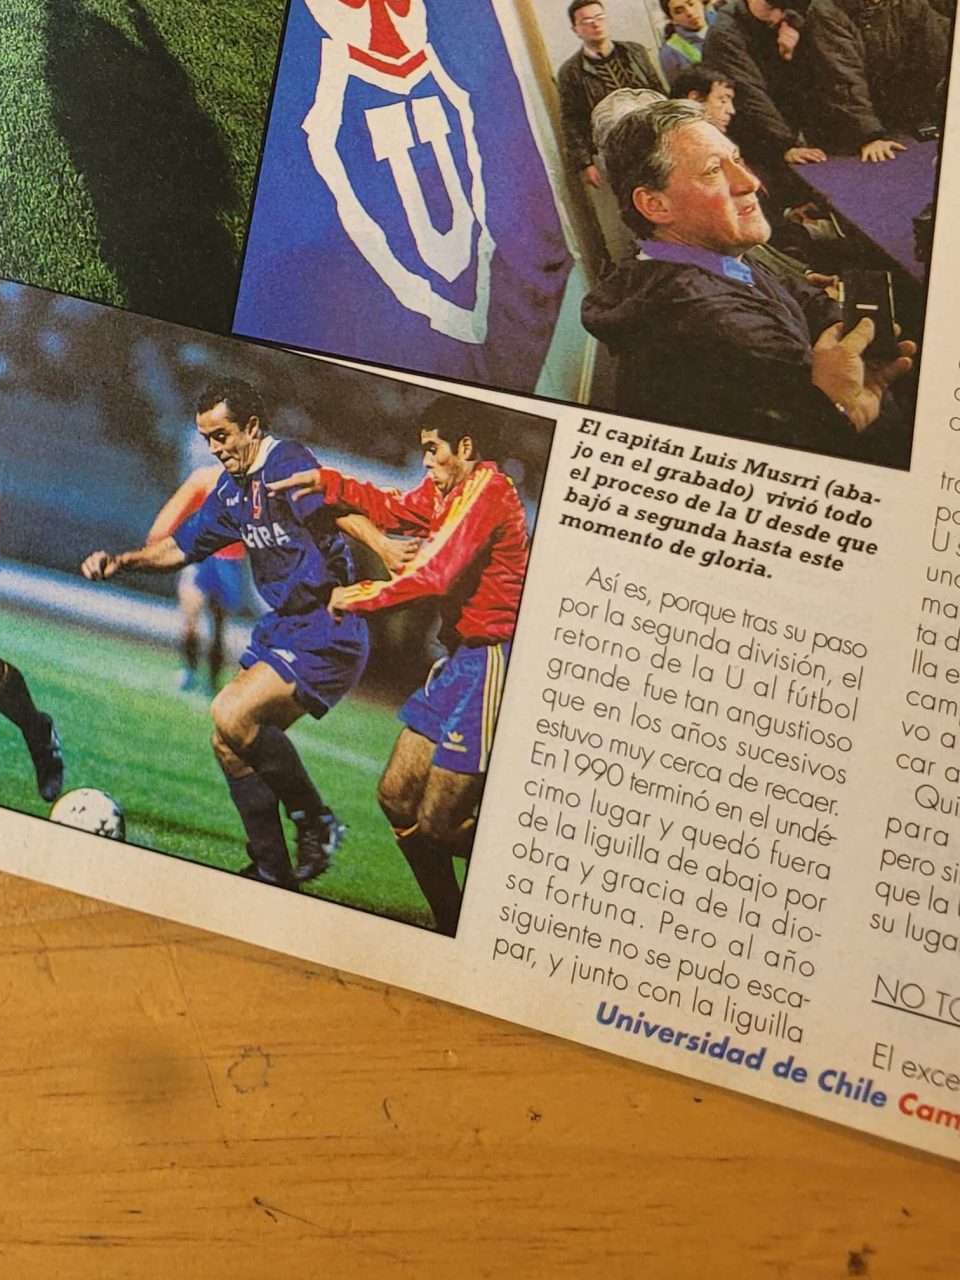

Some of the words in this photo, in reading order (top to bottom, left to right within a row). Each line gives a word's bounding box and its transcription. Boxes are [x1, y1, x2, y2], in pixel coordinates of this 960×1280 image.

[569, 440, 594, 460] jo
[599, 450, 625, 468] en
[630, 457, 654, 474] el
[653, 465, 755, 503] grabado)
[766, 490, 819, 516] vivió
[823, 503, 873, 529] todo
[576, 417, 602, 437] El
[605, 428, 685, 459] capitán
[688, 444, 739, 471] Luis
[740, 457, 821, 492] Musrri
[824, 478, 882, 506] (aba-
[568, 465, 592, 483] el
[590, 473, 680, 505] proceso
[684, 493, 712, 514] de
[715, 499, 738, 521] la
[744, 506, 763, 525] U
[765, 513, 832, 544] desde
[836, 535, 879, 556] que
[557, 596, 600, 620] por
[603, 598, 626, 628] la
[630, 615, 732, 656] segunda
[736, 636, 833, 688] división,
[841, 665, 865, 692] el
[584, 565, 621, 594] Así
[623, 582, 652, 607] es,
[658, 591, 737, 626] porque
[741, 608, 779, 636] tras
[782, 623, 807, 644] su
[810, 631, 869, 659] paso
[884, 816, 950, 848] para
[595, 1000, 768, 1071] Universidad
[771, 1054, 809, 1084] de
[817, 1068, 888, 1108] Chile
